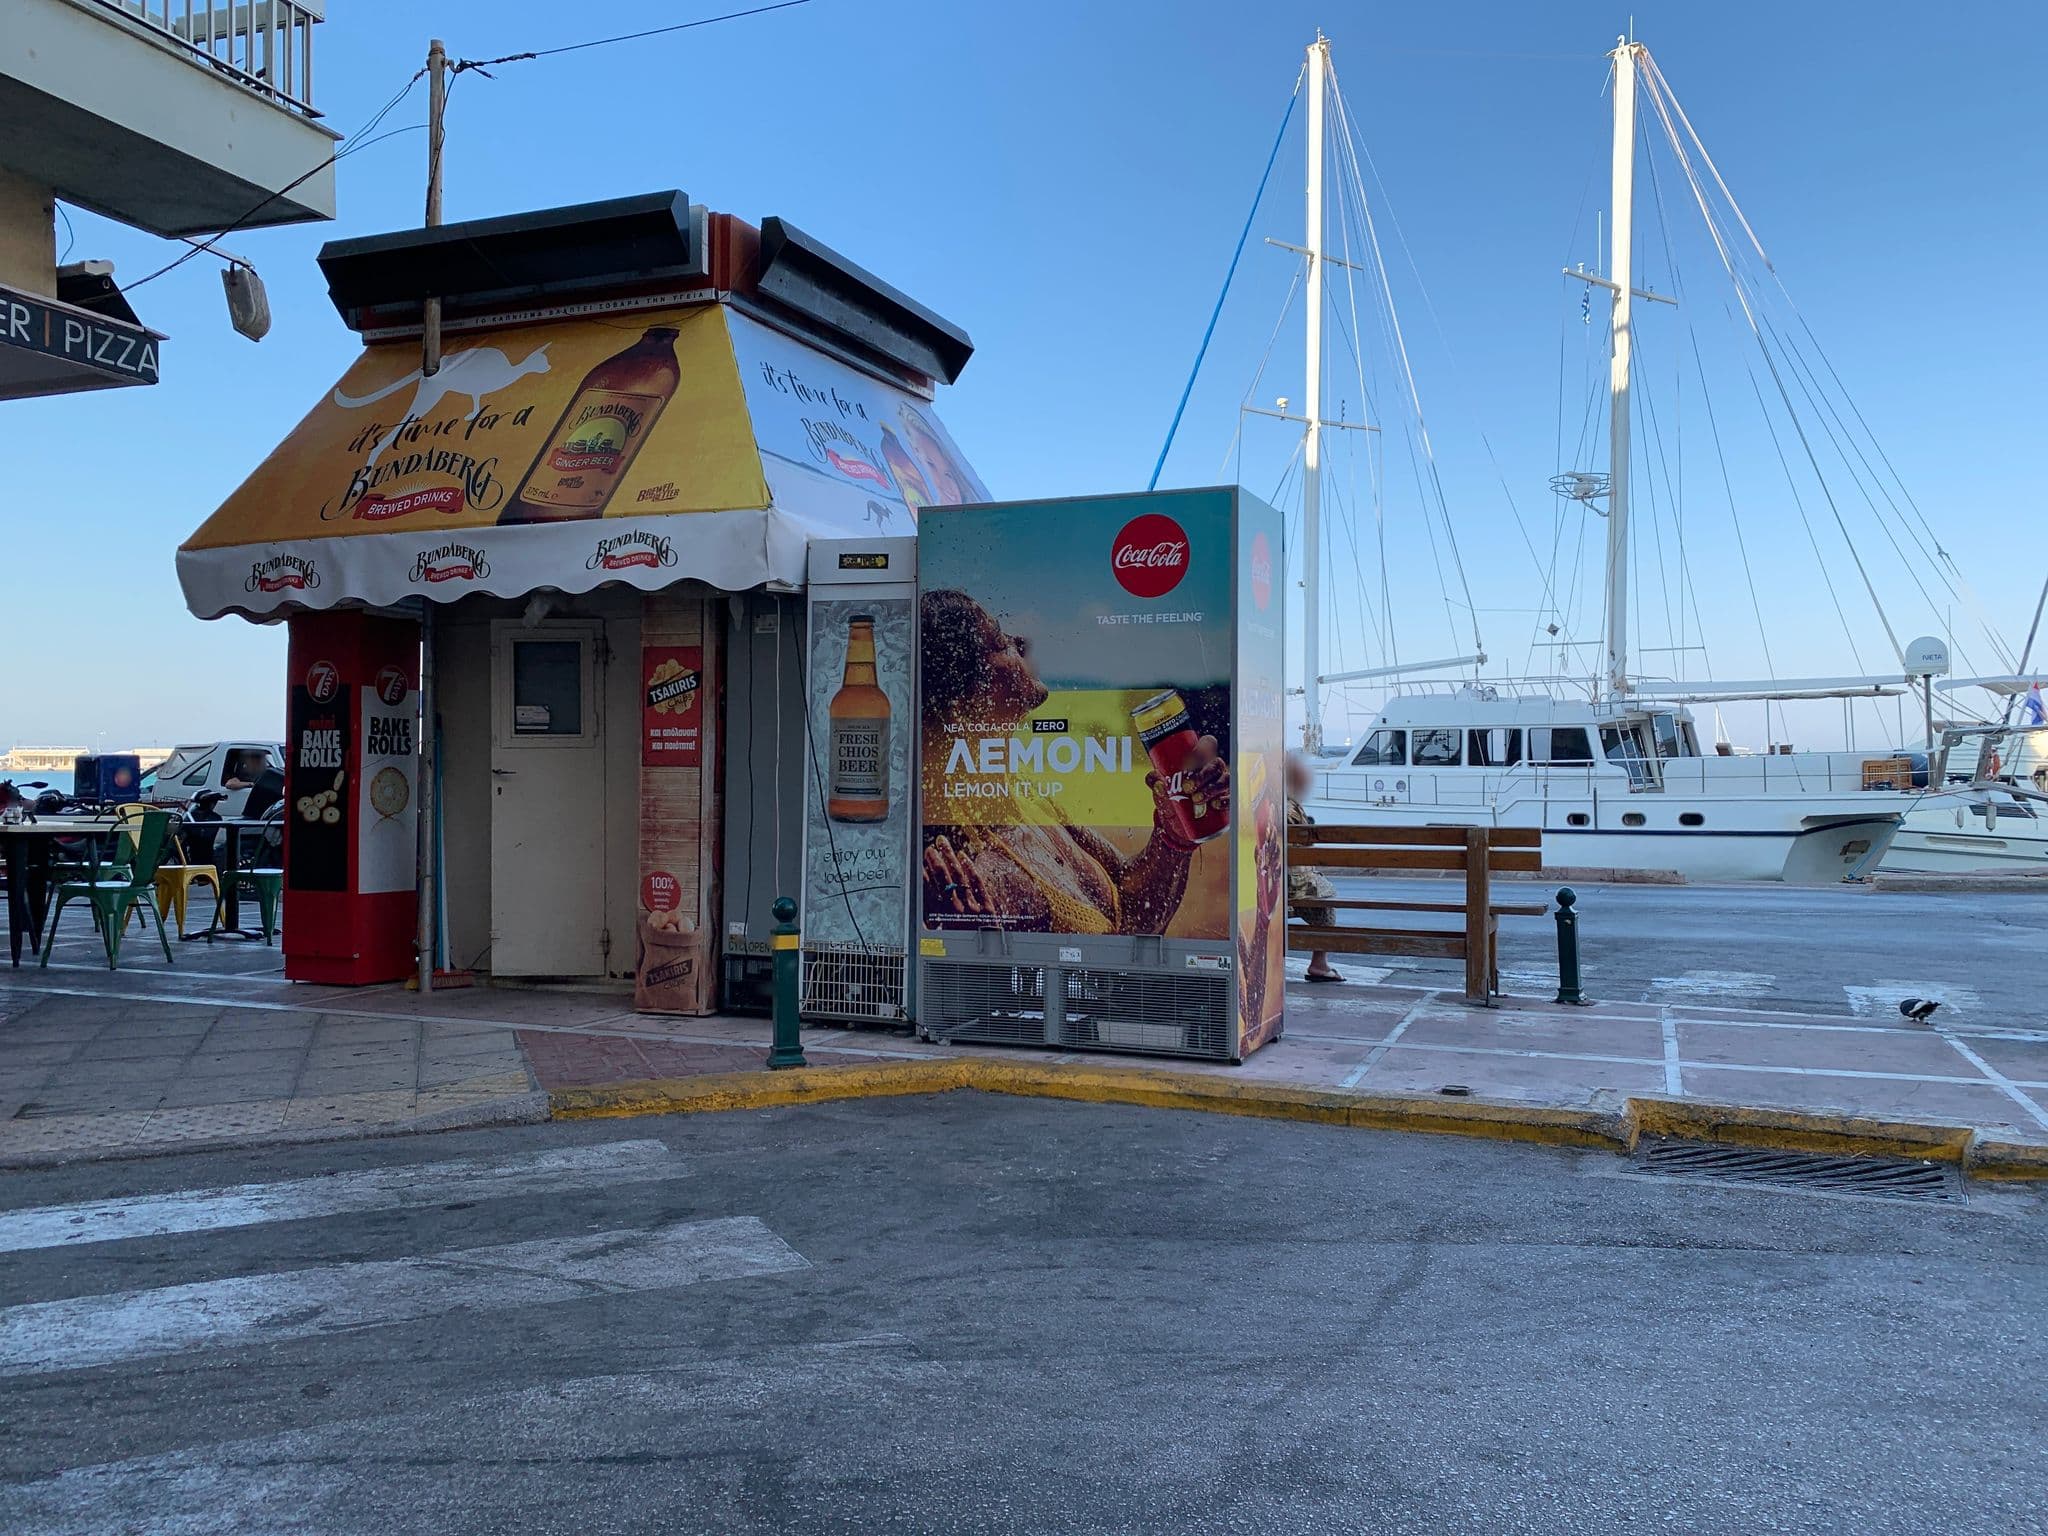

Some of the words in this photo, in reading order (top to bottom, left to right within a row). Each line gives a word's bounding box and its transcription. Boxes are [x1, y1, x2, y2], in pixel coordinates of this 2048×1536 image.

[65, 319, 159, 378] PIZZA
[348, 423, 384, 454] it's
[384, 413, 460, 450] time
[465, 404, 512, 440] for
[512, 405, 535, 426] a
[555, 457, 589, 468] GINGER
[590, 456, 614, 466] BEER
[320, 447, 503, 520] BUNDABERG
[367, 498, 410, 515] BREWED
[413, 490, 453, 506] DRINKS
[585, 528, 679, 570] BUNDABERG
[1115, 541, 1187, 569] Coca-Cola
[244, 552, 321, 592] BUNDABERG
[408, 541, 491, 582] BUNDABERG
[1096, 614, 1130, 625] TASTE
[1132, 613, 1153, 624] THE
[1155, 611, 1202, 623] FEELING
[311, 666, 331, 698] 7
[321, 671, 336, 697] DAYS
[380, 671, 400, 701] 7
[649, 675, 697, 703] TSAKIRIS
[370, 717, 410, 737] BAKE
[1035, 721, 1065, 731] ZERO
[302, 730, 341, 749] BAKE
[367, 735, 412, 756] ROLLS
[839, 733, 879, 745] FRESH
[300, 748, 343, 768] ROLLS
[838, 746, 879, 758] CHIOS
[838, 760, 879, 773] BEER
[943, 783, 1009, 798] LEMON
[1015, 782, 1031, 798] IT
[1038, 782, 1063, 798] UP
[823, 848, 860, 866] enjoy
[865, 847, 889, 860] our
[651, 876, 674, 890] 100%
[824, 869, 852, 884] local
[857, 867, 891, 882] beer
[649, 962, 690, 984] TSAKIRIS
